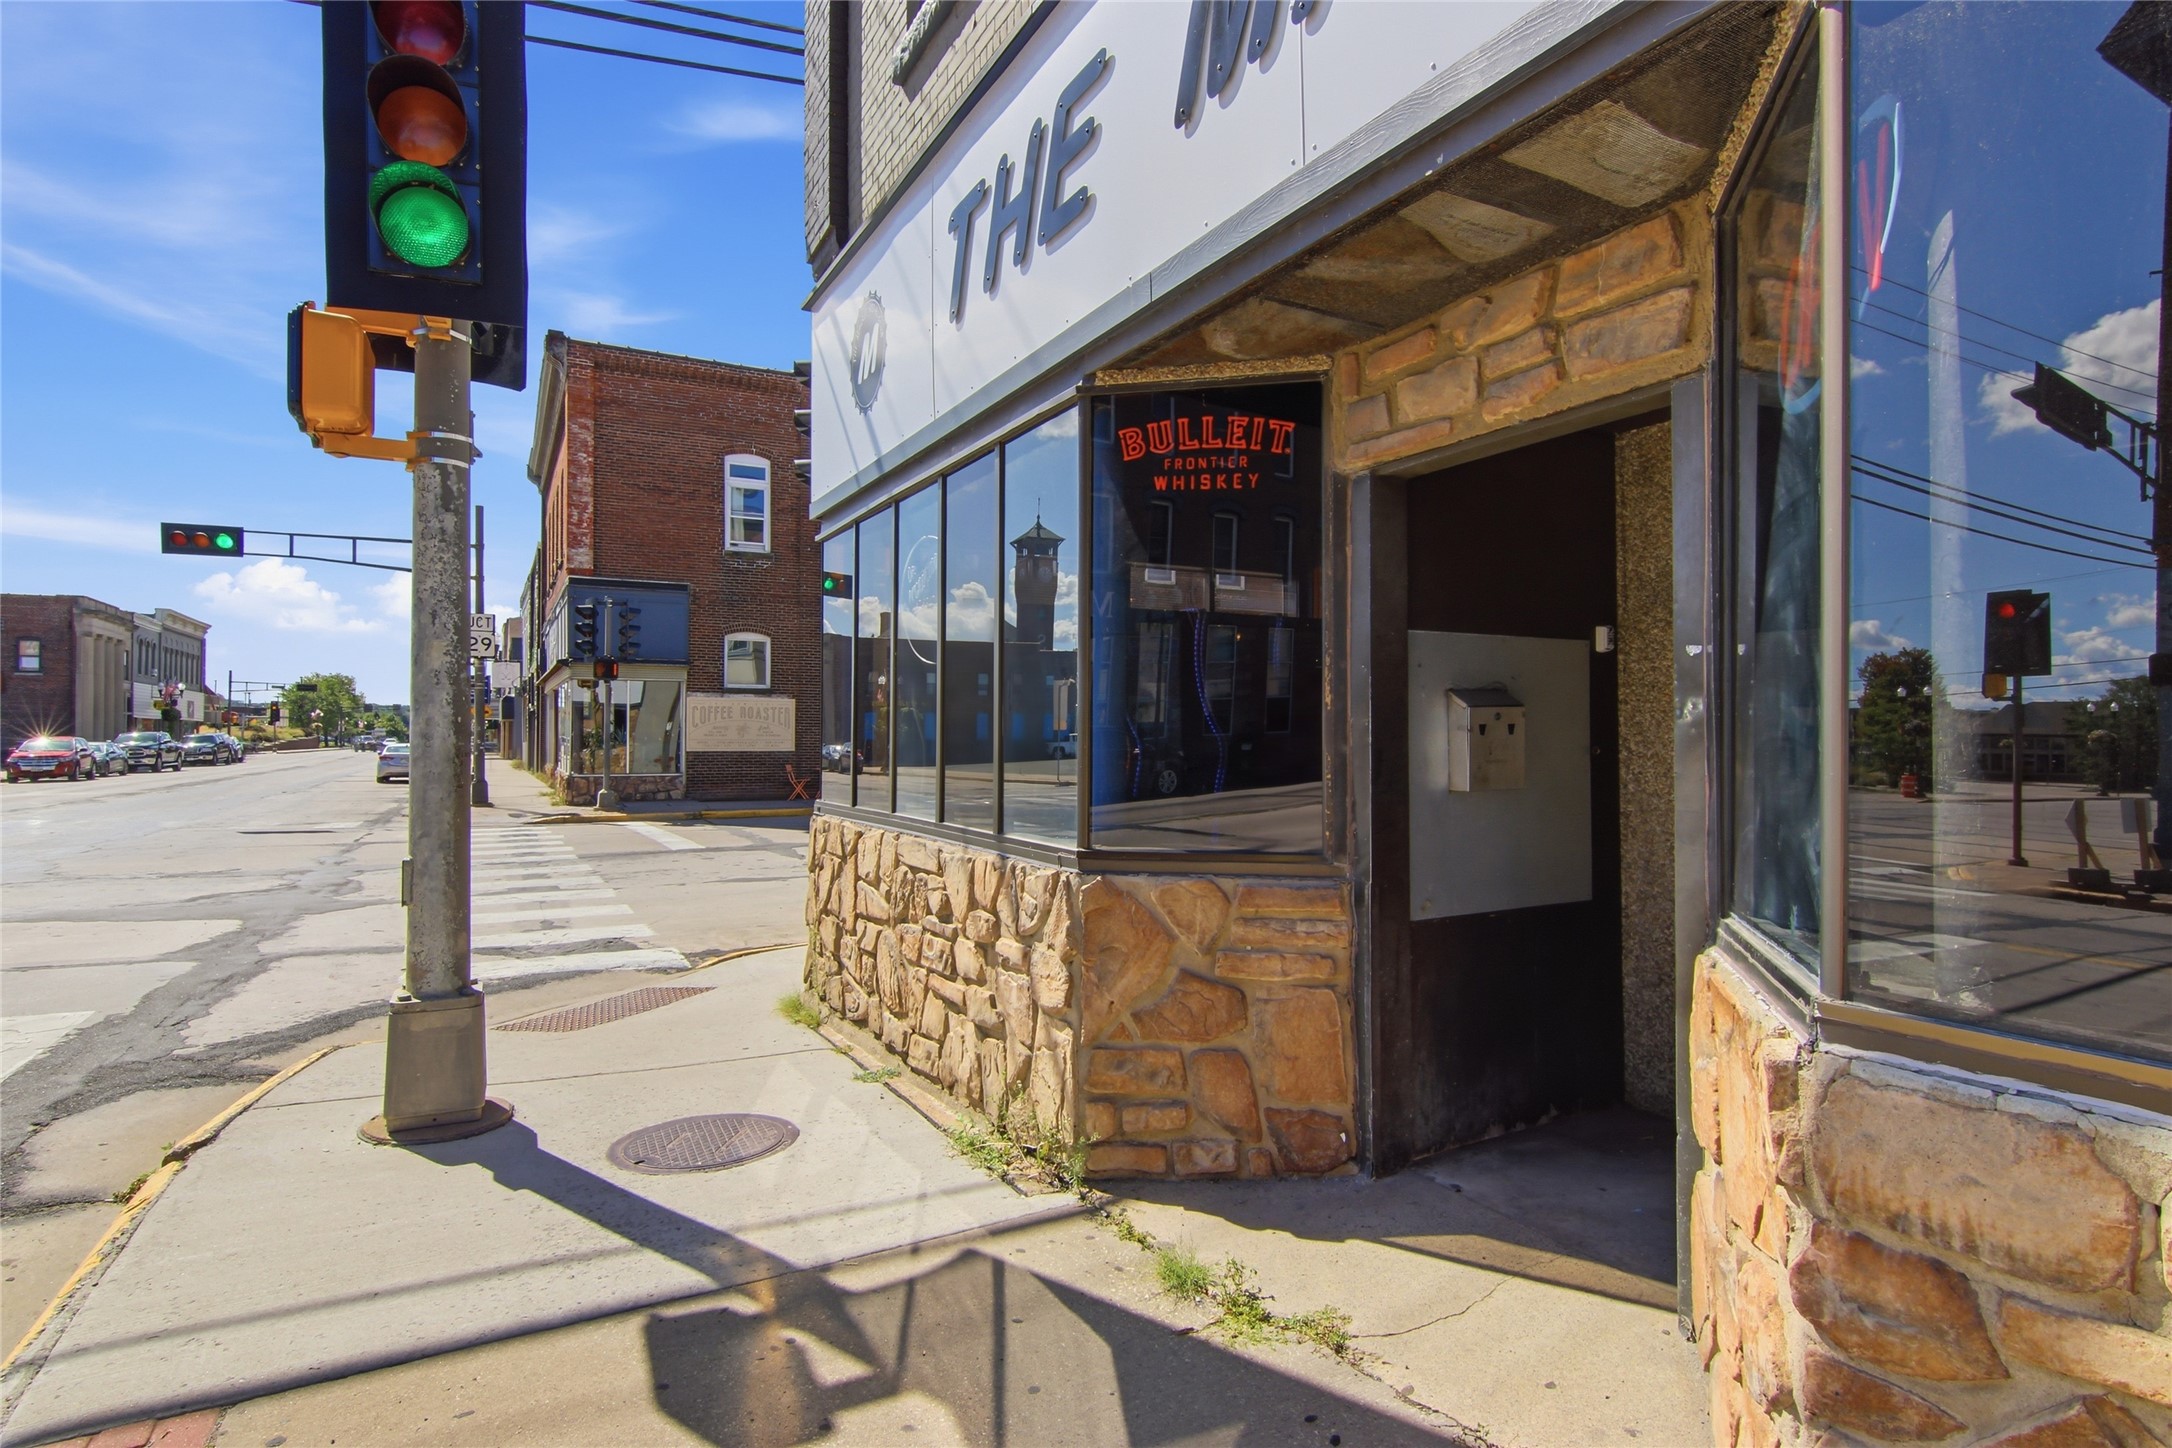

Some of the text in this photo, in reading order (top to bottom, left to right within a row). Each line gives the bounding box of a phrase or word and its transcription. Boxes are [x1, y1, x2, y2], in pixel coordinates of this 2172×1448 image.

[949, 48, 1107, 323] THE
[857, 322, 879, 385] M
[1164, 456, 1248, 470] FRONTIER
[1154, 473, 1259, 491] WHISKEY
[691, 706, 790, 729] COFFEE ROASTER
